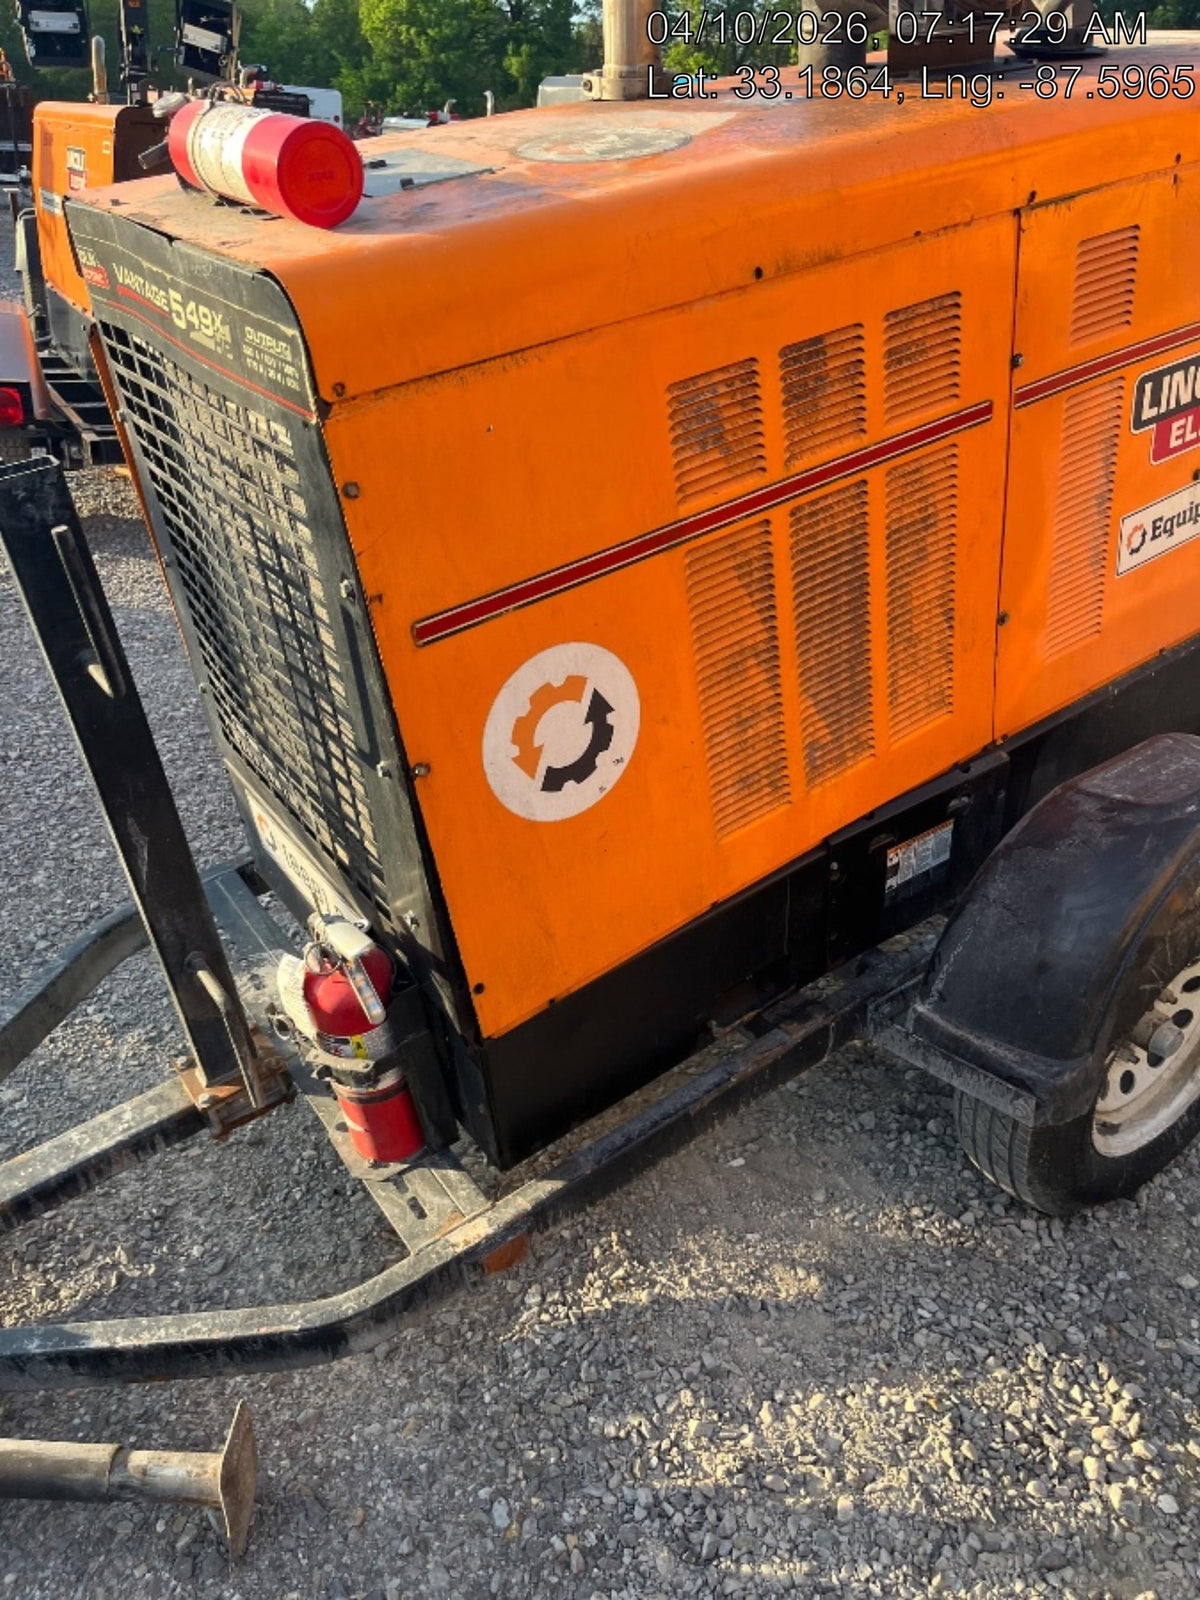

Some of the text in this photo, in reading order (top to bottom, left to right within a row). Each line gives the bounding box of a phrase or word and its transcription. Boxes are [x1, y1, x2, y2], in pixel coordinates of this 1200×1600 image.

[112, 262, 169, 312] VANTAGE
[1141, 365, 1200, 421] LIN
[1169, 414, 1200, 448] EL
